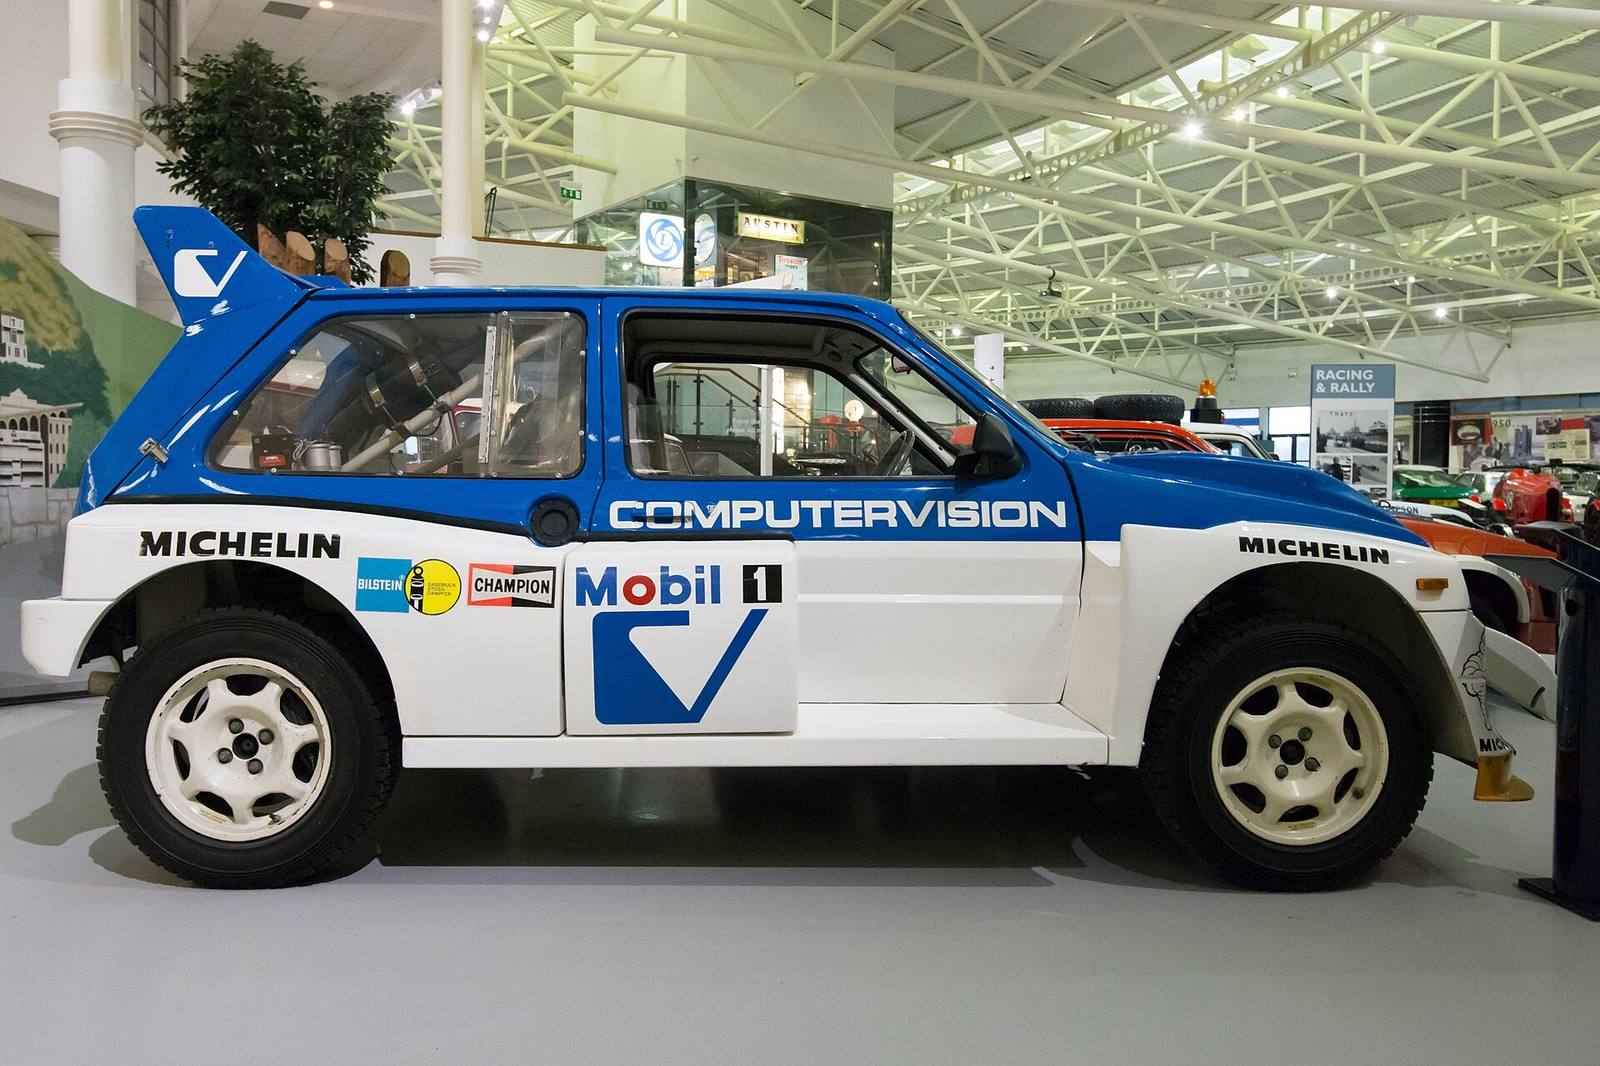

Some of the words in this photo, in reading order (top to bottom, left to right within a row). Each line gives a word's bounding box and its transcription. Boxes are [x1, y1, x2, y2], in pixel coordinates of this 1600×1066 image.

[744, 217, 798, 232] AUSTIN
[1316, 369, 1373, 380] RACING
[1315, 382, 1326, 393] &
[1330, 382, 1375, 393] RALLY
[608, 499, 1067, 529] COMPUTERVISION
[139, 530, 341, 558] MICHELIN
[1239, 536, 1390, 565] MICHELIN
[358, 578, 403, 592] BILSTEIN
[474, 577, 550, 594] CHAMPION
[575, 564, 721, 607] Mobil
[753, 566, 767, 601] 1
